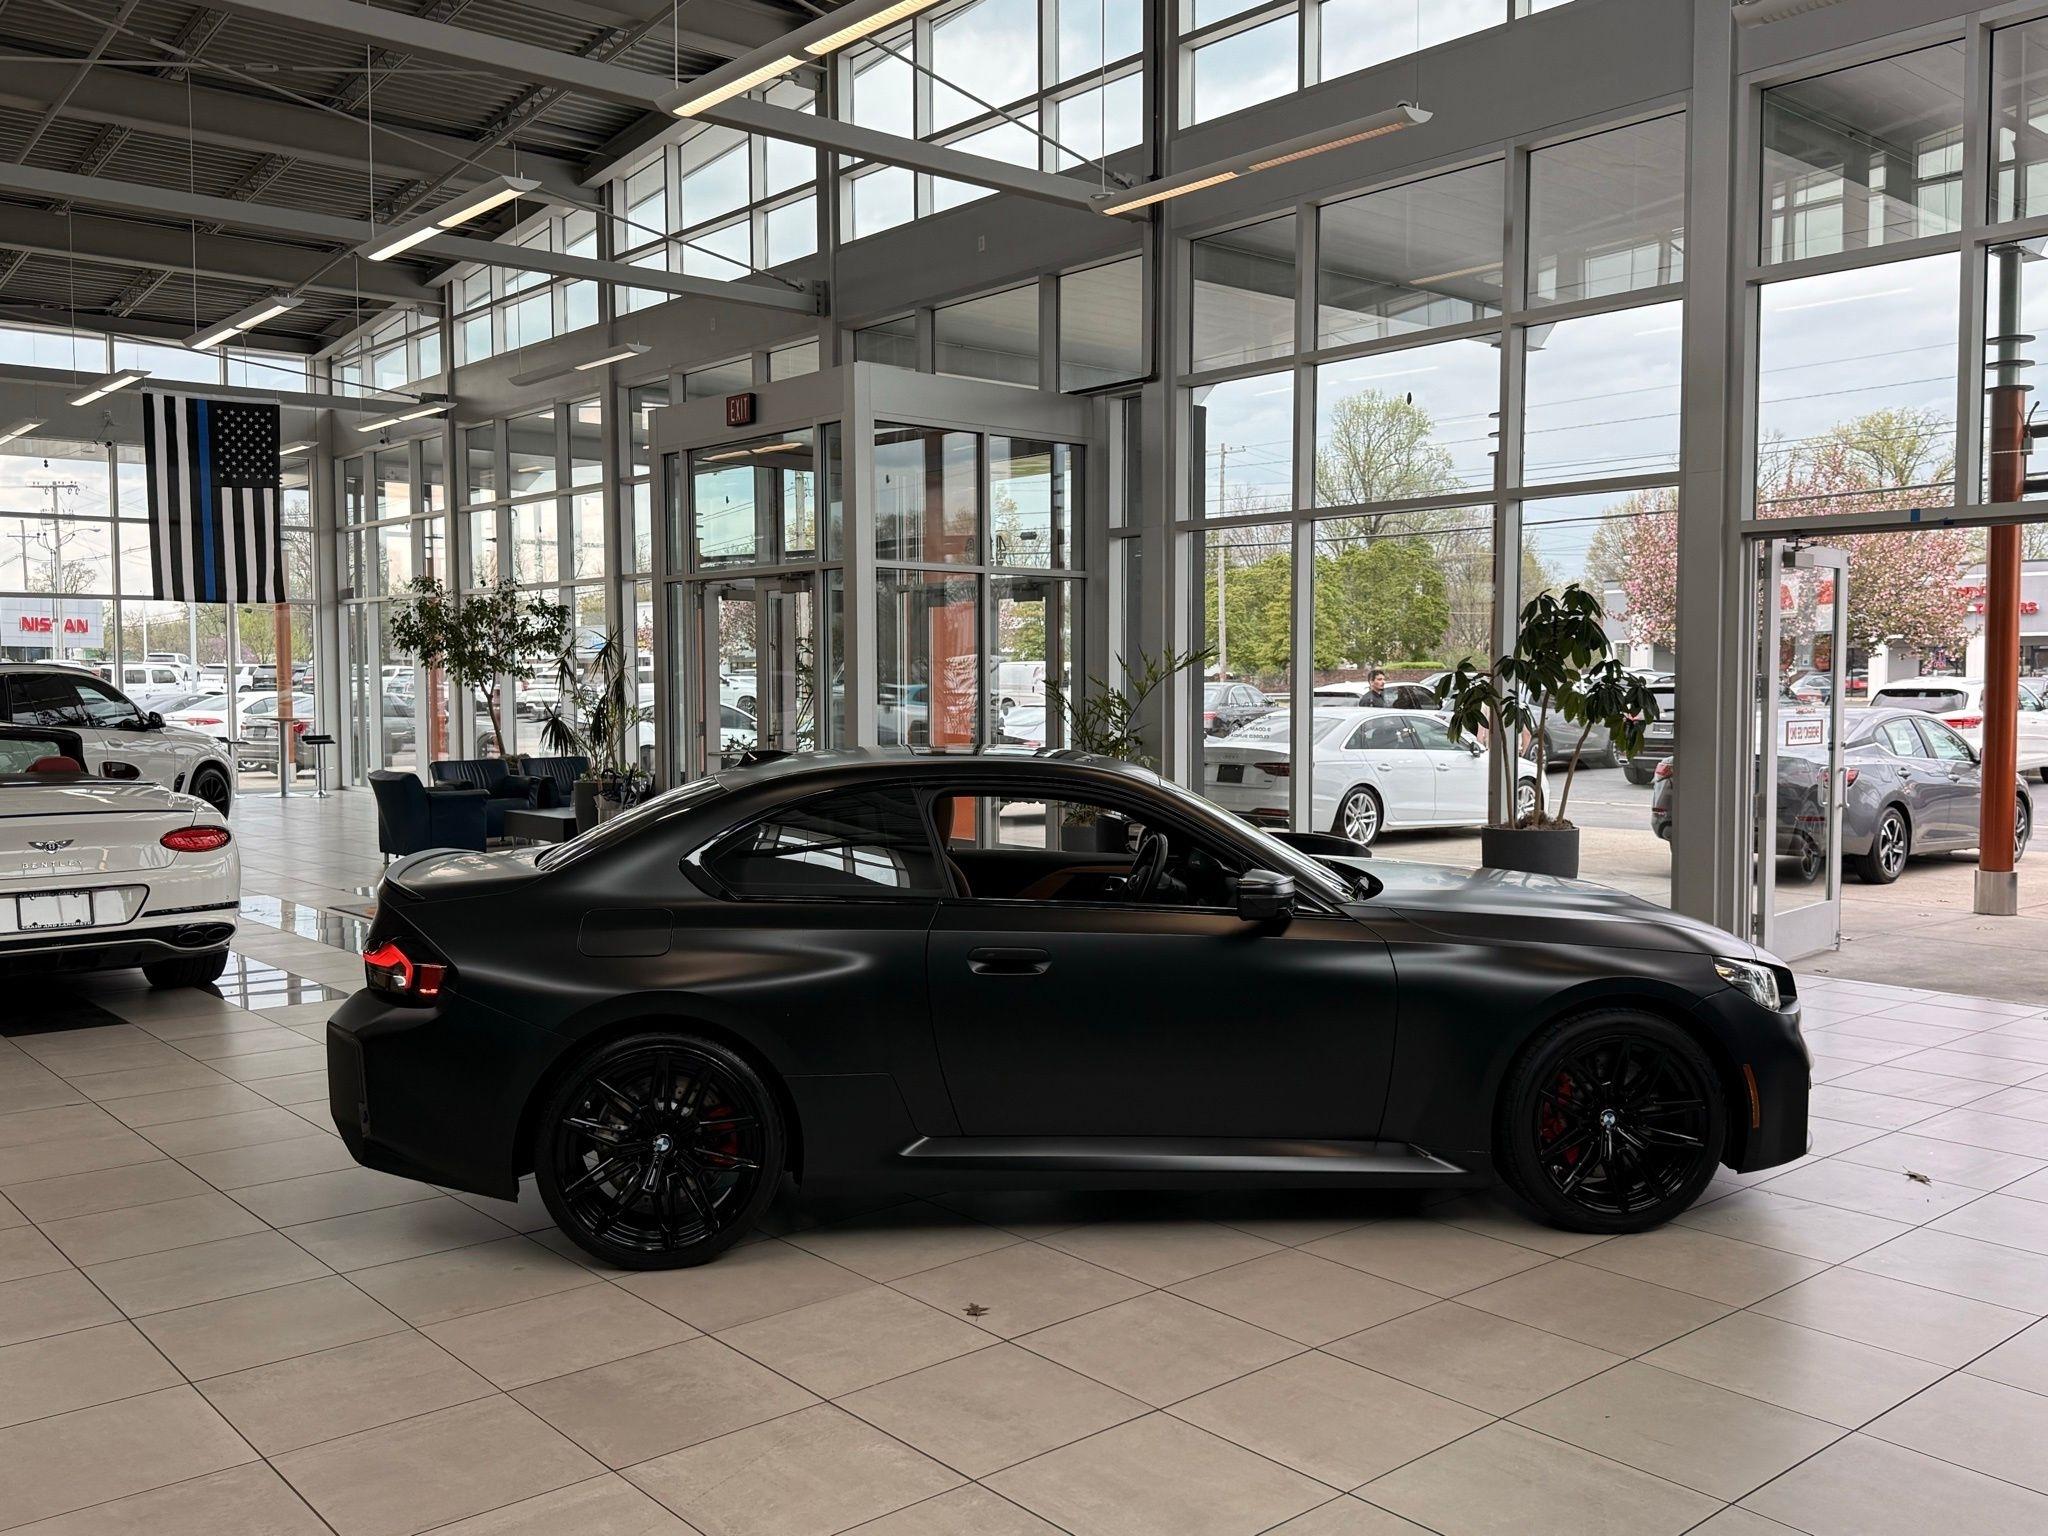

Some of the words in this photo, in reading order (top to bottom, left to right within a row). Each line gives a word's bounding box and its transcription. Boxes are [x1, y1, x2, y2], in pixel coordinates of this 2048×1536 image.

[730, 397, 748, 422] EXIT
[19, 616, 89, 633] NISAN
[22, 860, 83, 869] BENTLEY
